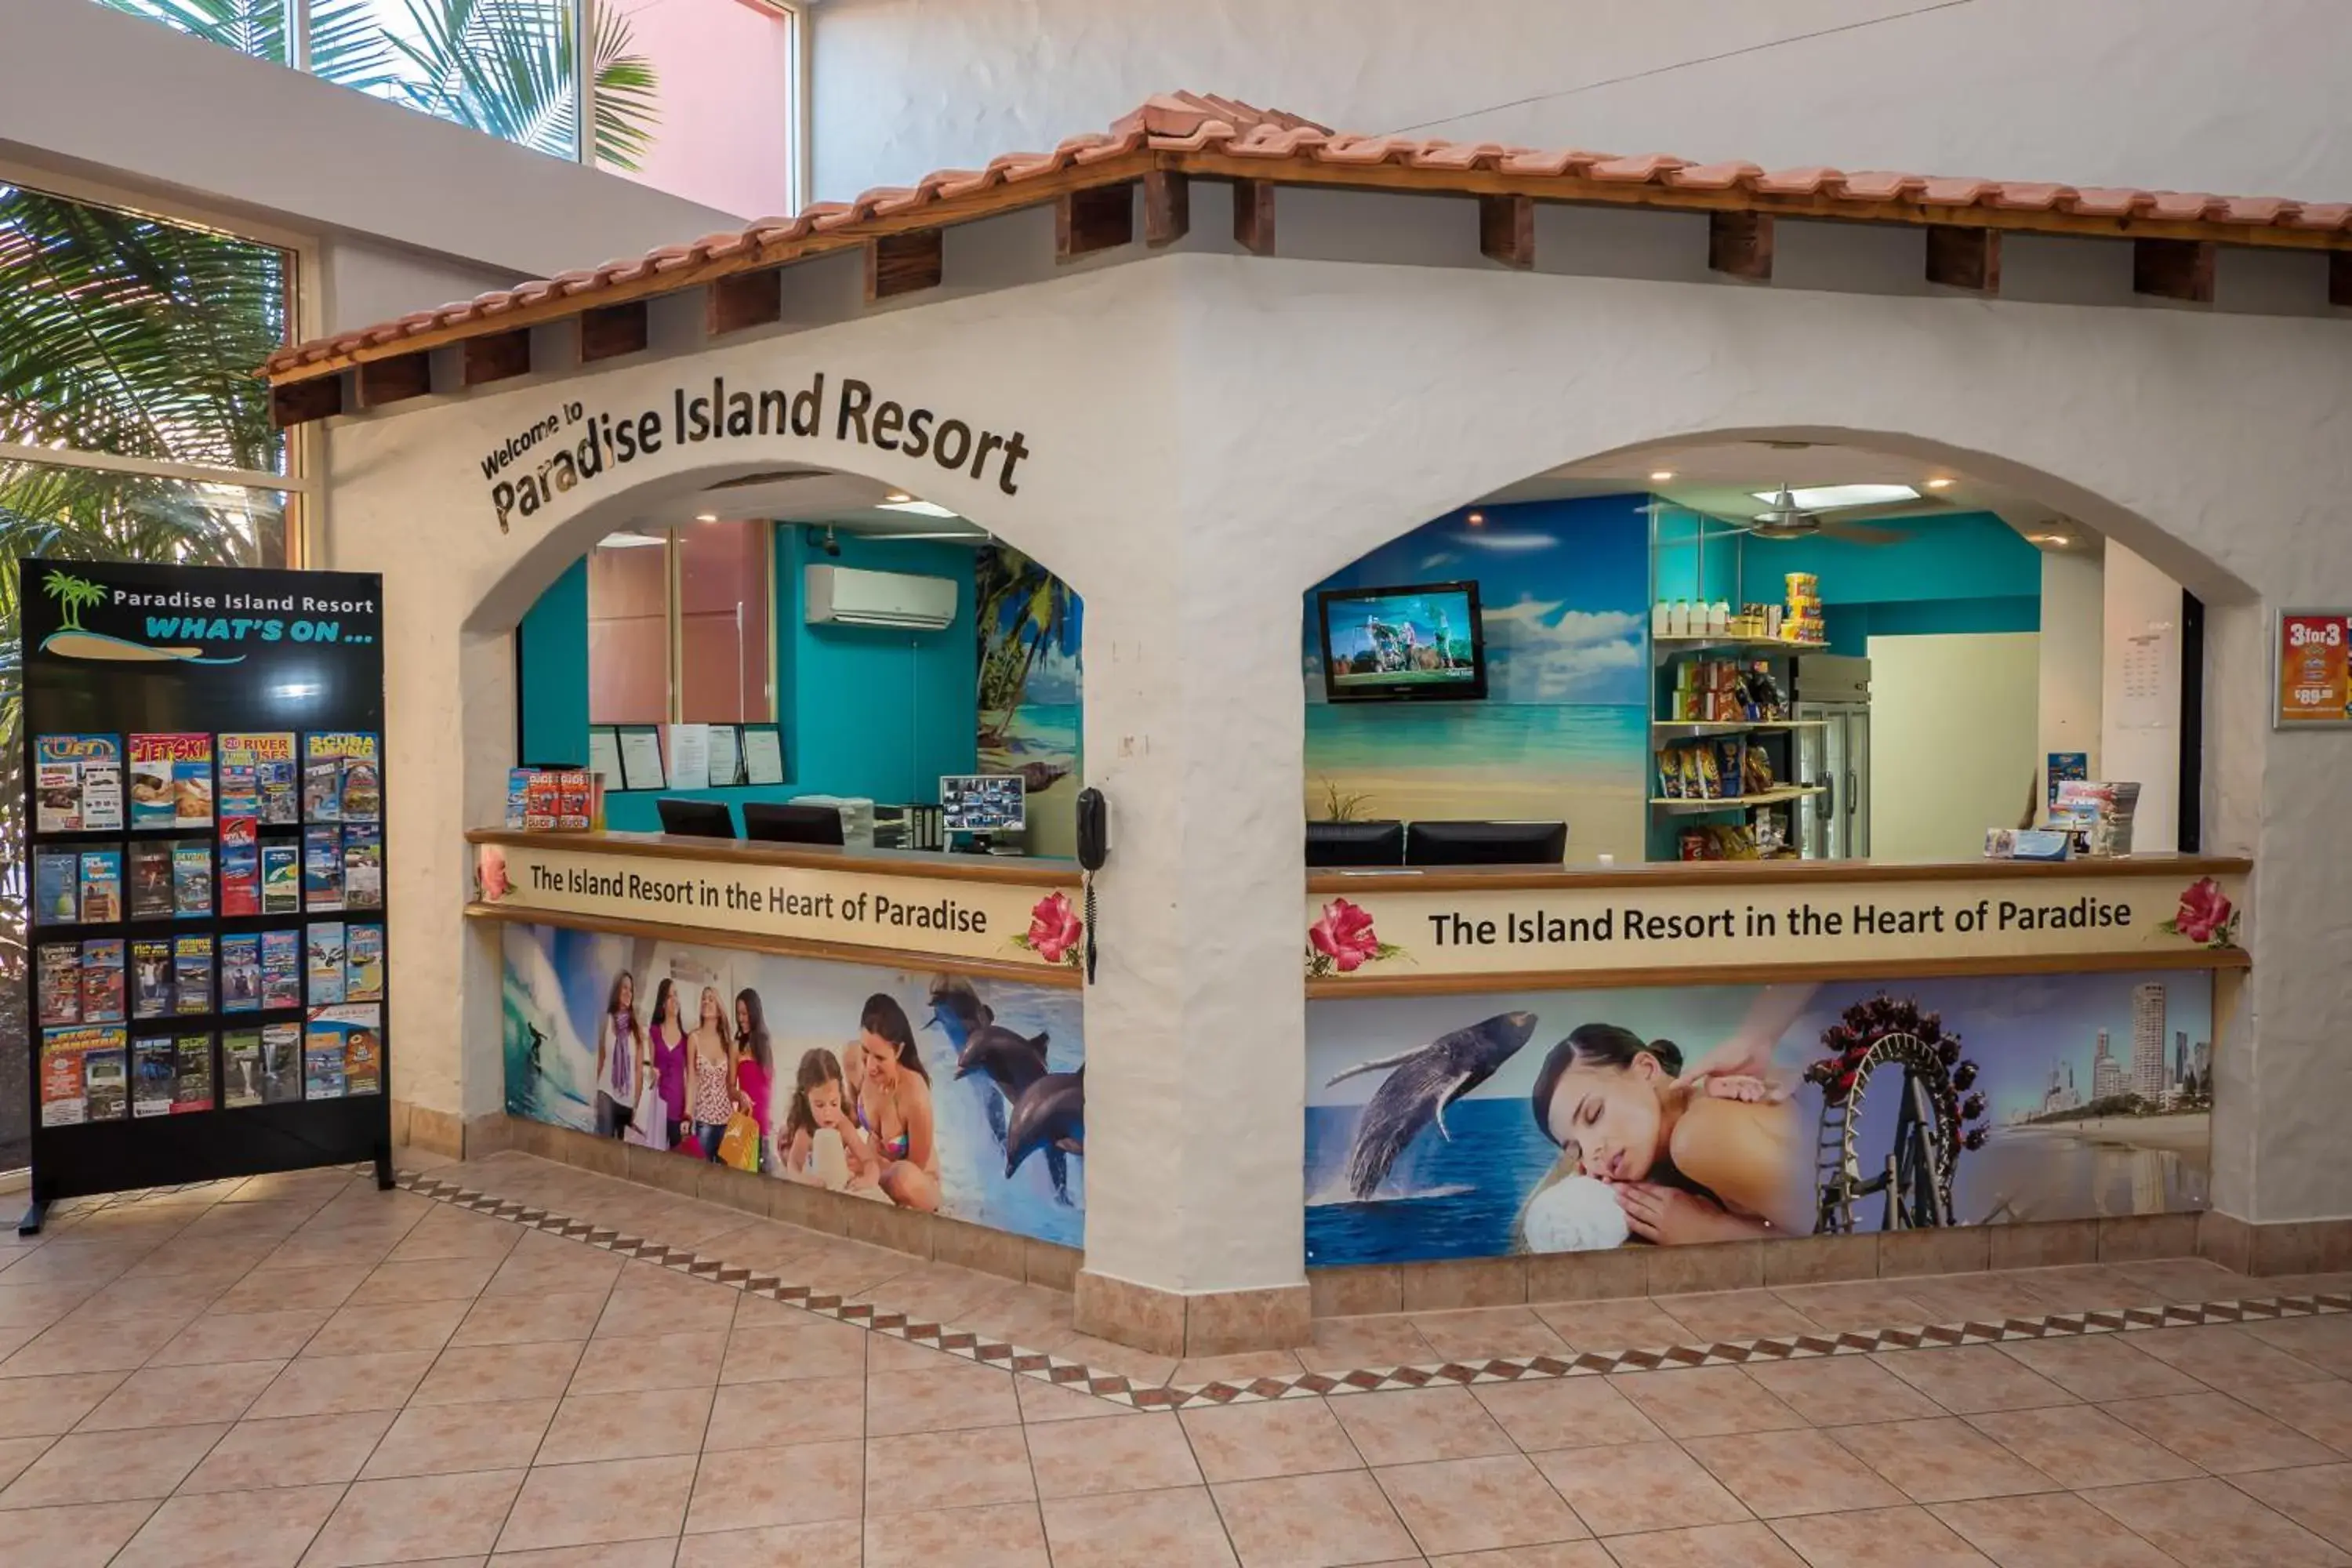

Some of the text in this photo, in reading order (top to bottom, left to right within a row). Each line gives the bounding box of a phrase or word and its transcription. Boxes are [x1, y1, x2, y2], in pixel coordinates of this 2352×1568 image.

[480, 401, 583, 481] Welcome to
[492, 372, 1029, 535] Paradise Island Resort
[114, 590, 374, 614] Paradise Island Resort
[146, 616, 285, 641] WHAT'S
[244, 739, 288, 750] RIVER
[530, 864, 987, 934] The Island Resort in the Heart of Paradise
[1428, 896, 2132, 946] The Island Resort in the Heart of Paradise
